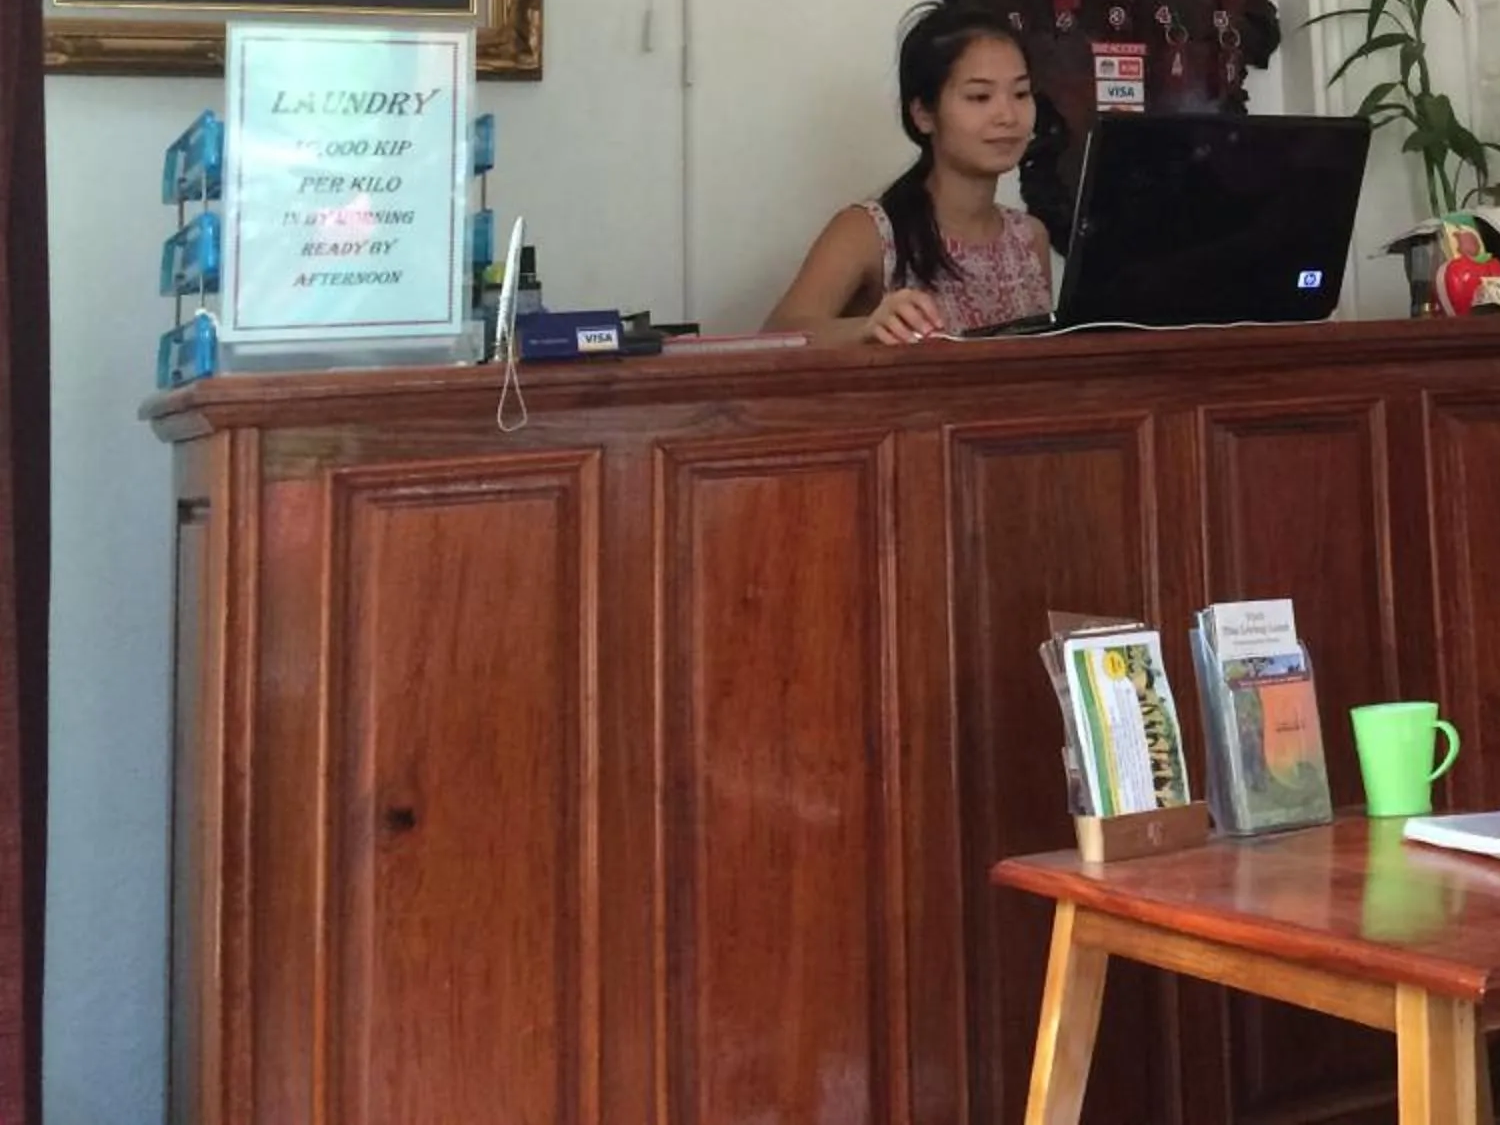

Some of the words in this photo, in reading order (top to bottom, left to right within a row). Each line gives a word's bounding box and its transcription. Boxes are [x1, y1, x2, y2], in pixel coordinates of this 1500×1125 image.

[1108, 87, 1135, 98] VISA
[271, 89, 441, 115] LAUNDRY
[373, 140, 413, 156] KIP
[298, 176, 345, 193] PER
[351, 176, 403, 193] KILO
[301, 239, 368, 257] READY
[369, 238, 399, 255] BY
[293, 270, 403, 287] AFTERNOON
[585, 333, 612, 344] VISA
